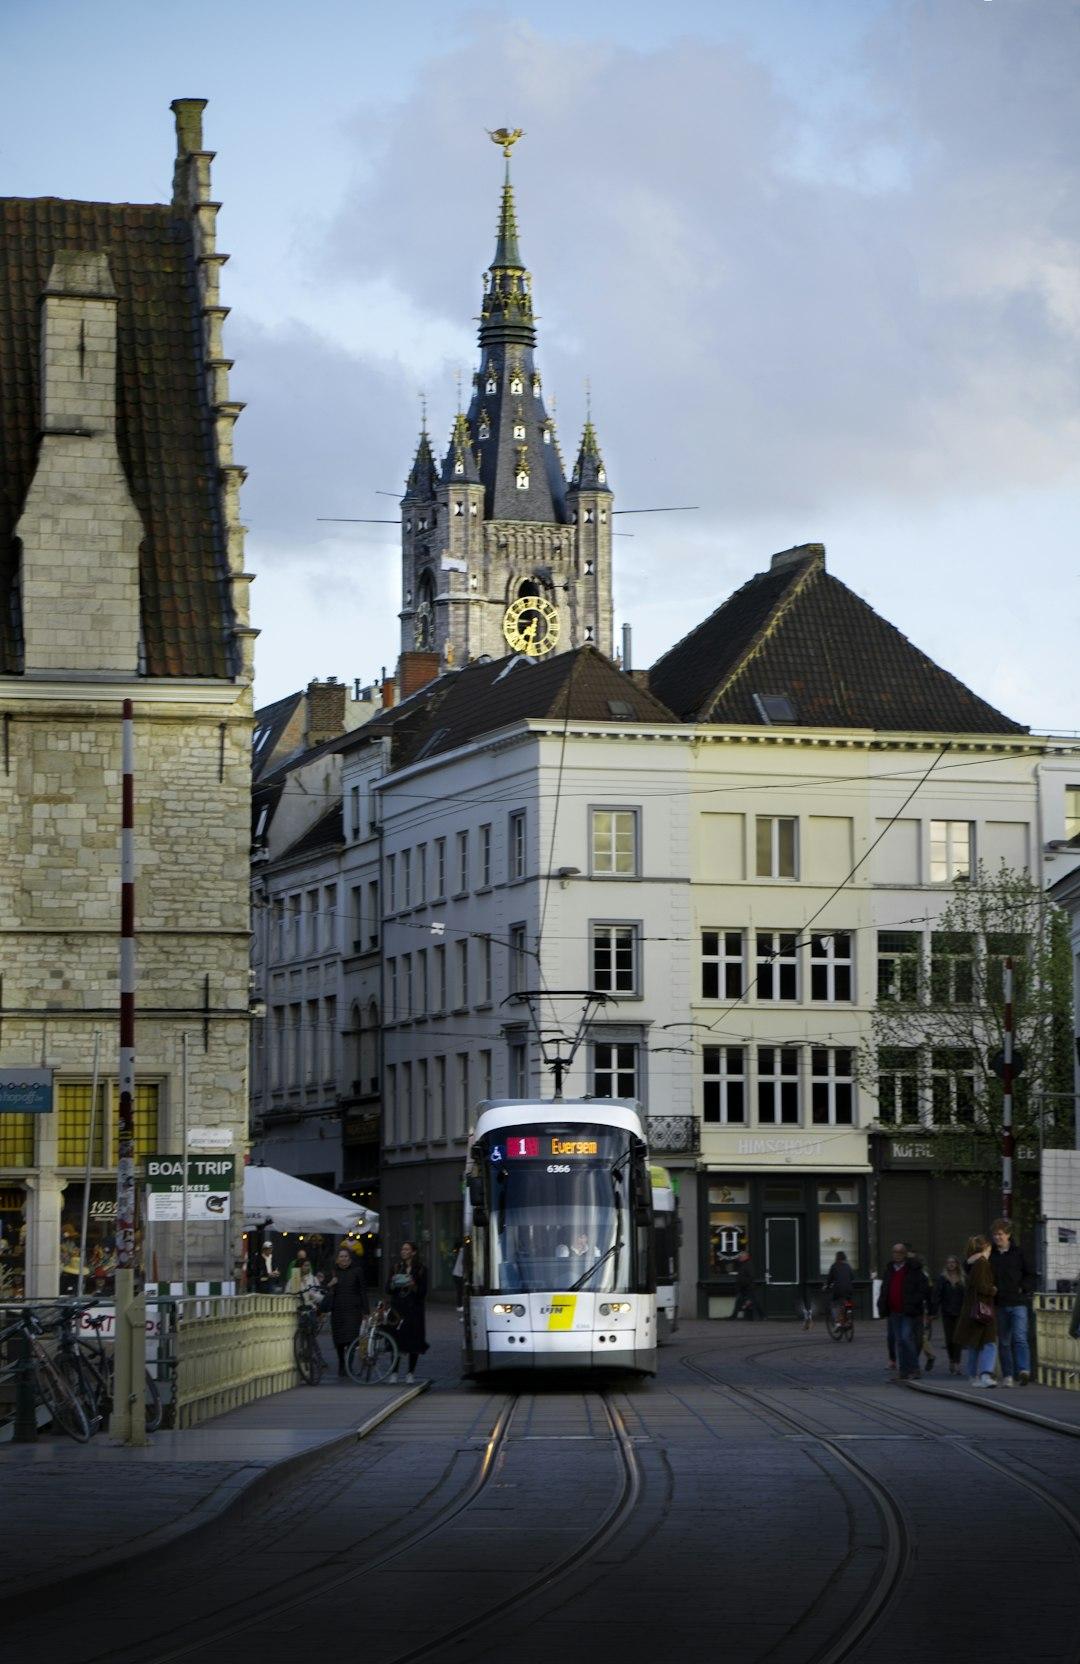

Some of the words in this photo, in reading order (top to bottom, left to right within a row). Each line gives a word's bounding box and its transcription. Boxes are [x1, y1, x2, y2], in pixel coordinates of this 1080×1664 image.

[518, 1138, 527, 1155] 1
[551, 1137, 597, 1155] Evergem
[738, 1139, 823, 1155] HIMSCHOOT
[148, 1161, 192, 1176] BOAT
[195, 1161, 233, 1176] TRIP
[546, 1164, 571, 1173] 6366
[720, 1231, 739, 1253] H
